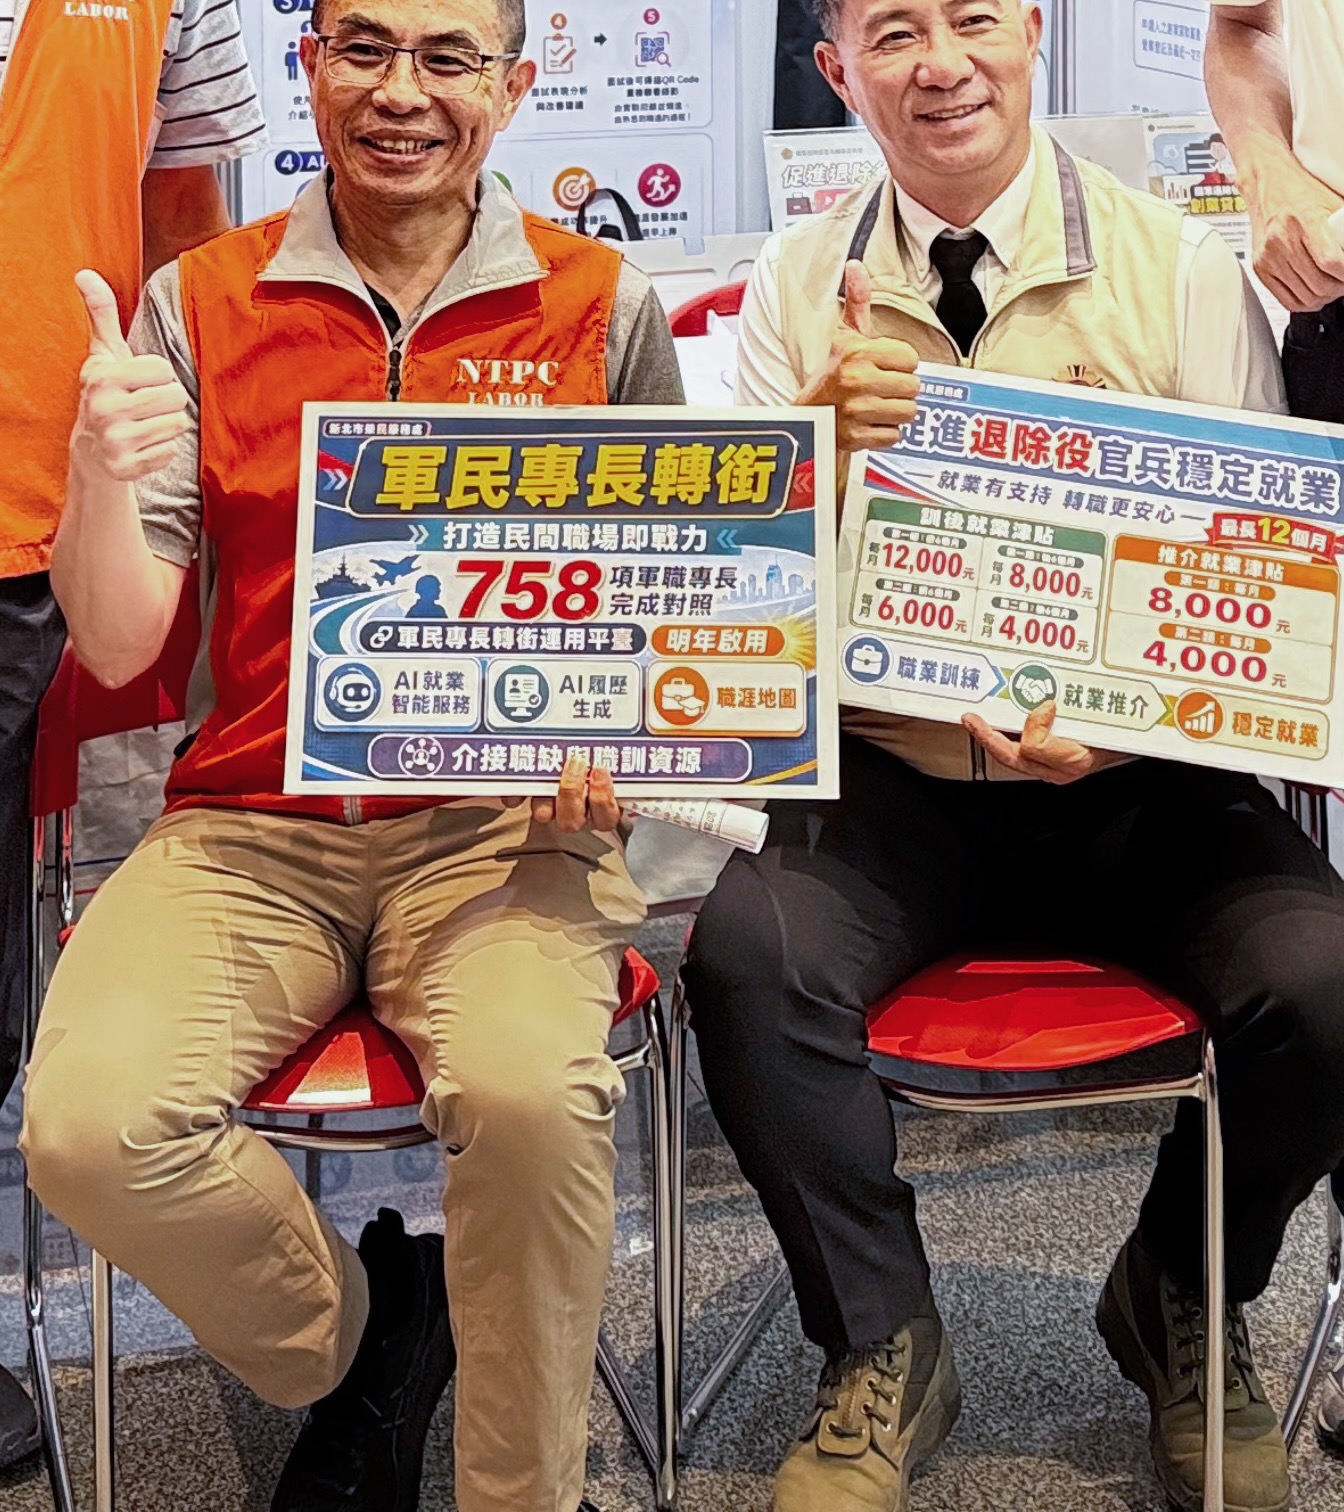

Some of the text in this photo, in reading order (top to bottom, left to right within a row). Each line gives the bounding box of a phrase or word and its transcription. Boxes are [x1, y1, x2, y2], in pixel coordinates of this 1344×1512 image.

[63, 1, 129, 21] LABOR
[281, 155, 294, 171] 4
[456, 358, 560, 387] NTPC
[467, 391, 544, 408] LABOR
[375, 442, 778, 511] 軍民專長轉銜
[937, 469, 1175, 525] 就業有支持 轉職更安心
[442, 521, 708, 552] 打造民間職場即戰力
[919, 506, 1055, 546] 訓後就業津貼
[1220, 517, 1327, 552] 最長12個月
[609, 566, 738, 590] 項軍職專長
[882, 542, 976, 581] 12,000元
[1158, 545, 1285, 582] 推介就業津貼
[454, 559, 603, 621] 758
[1009, 562, 1093, 600] 8,000元
[609, 592, 713, 617] 完成對照
[877, 595, 967, 633] 6,000元
[999, 615, 1089, 653] 4,000元
[897, 655, 982, 691] 職業訓練
[391, 694, 471, 715] 智能服務
[573, 698, 612, 719] 生成
[716, 687, 797, 709] 職涯地圖
[1063, 683, 1150, 719] 就業推介
[1232, 711, 1320, 748] 穩定就業
